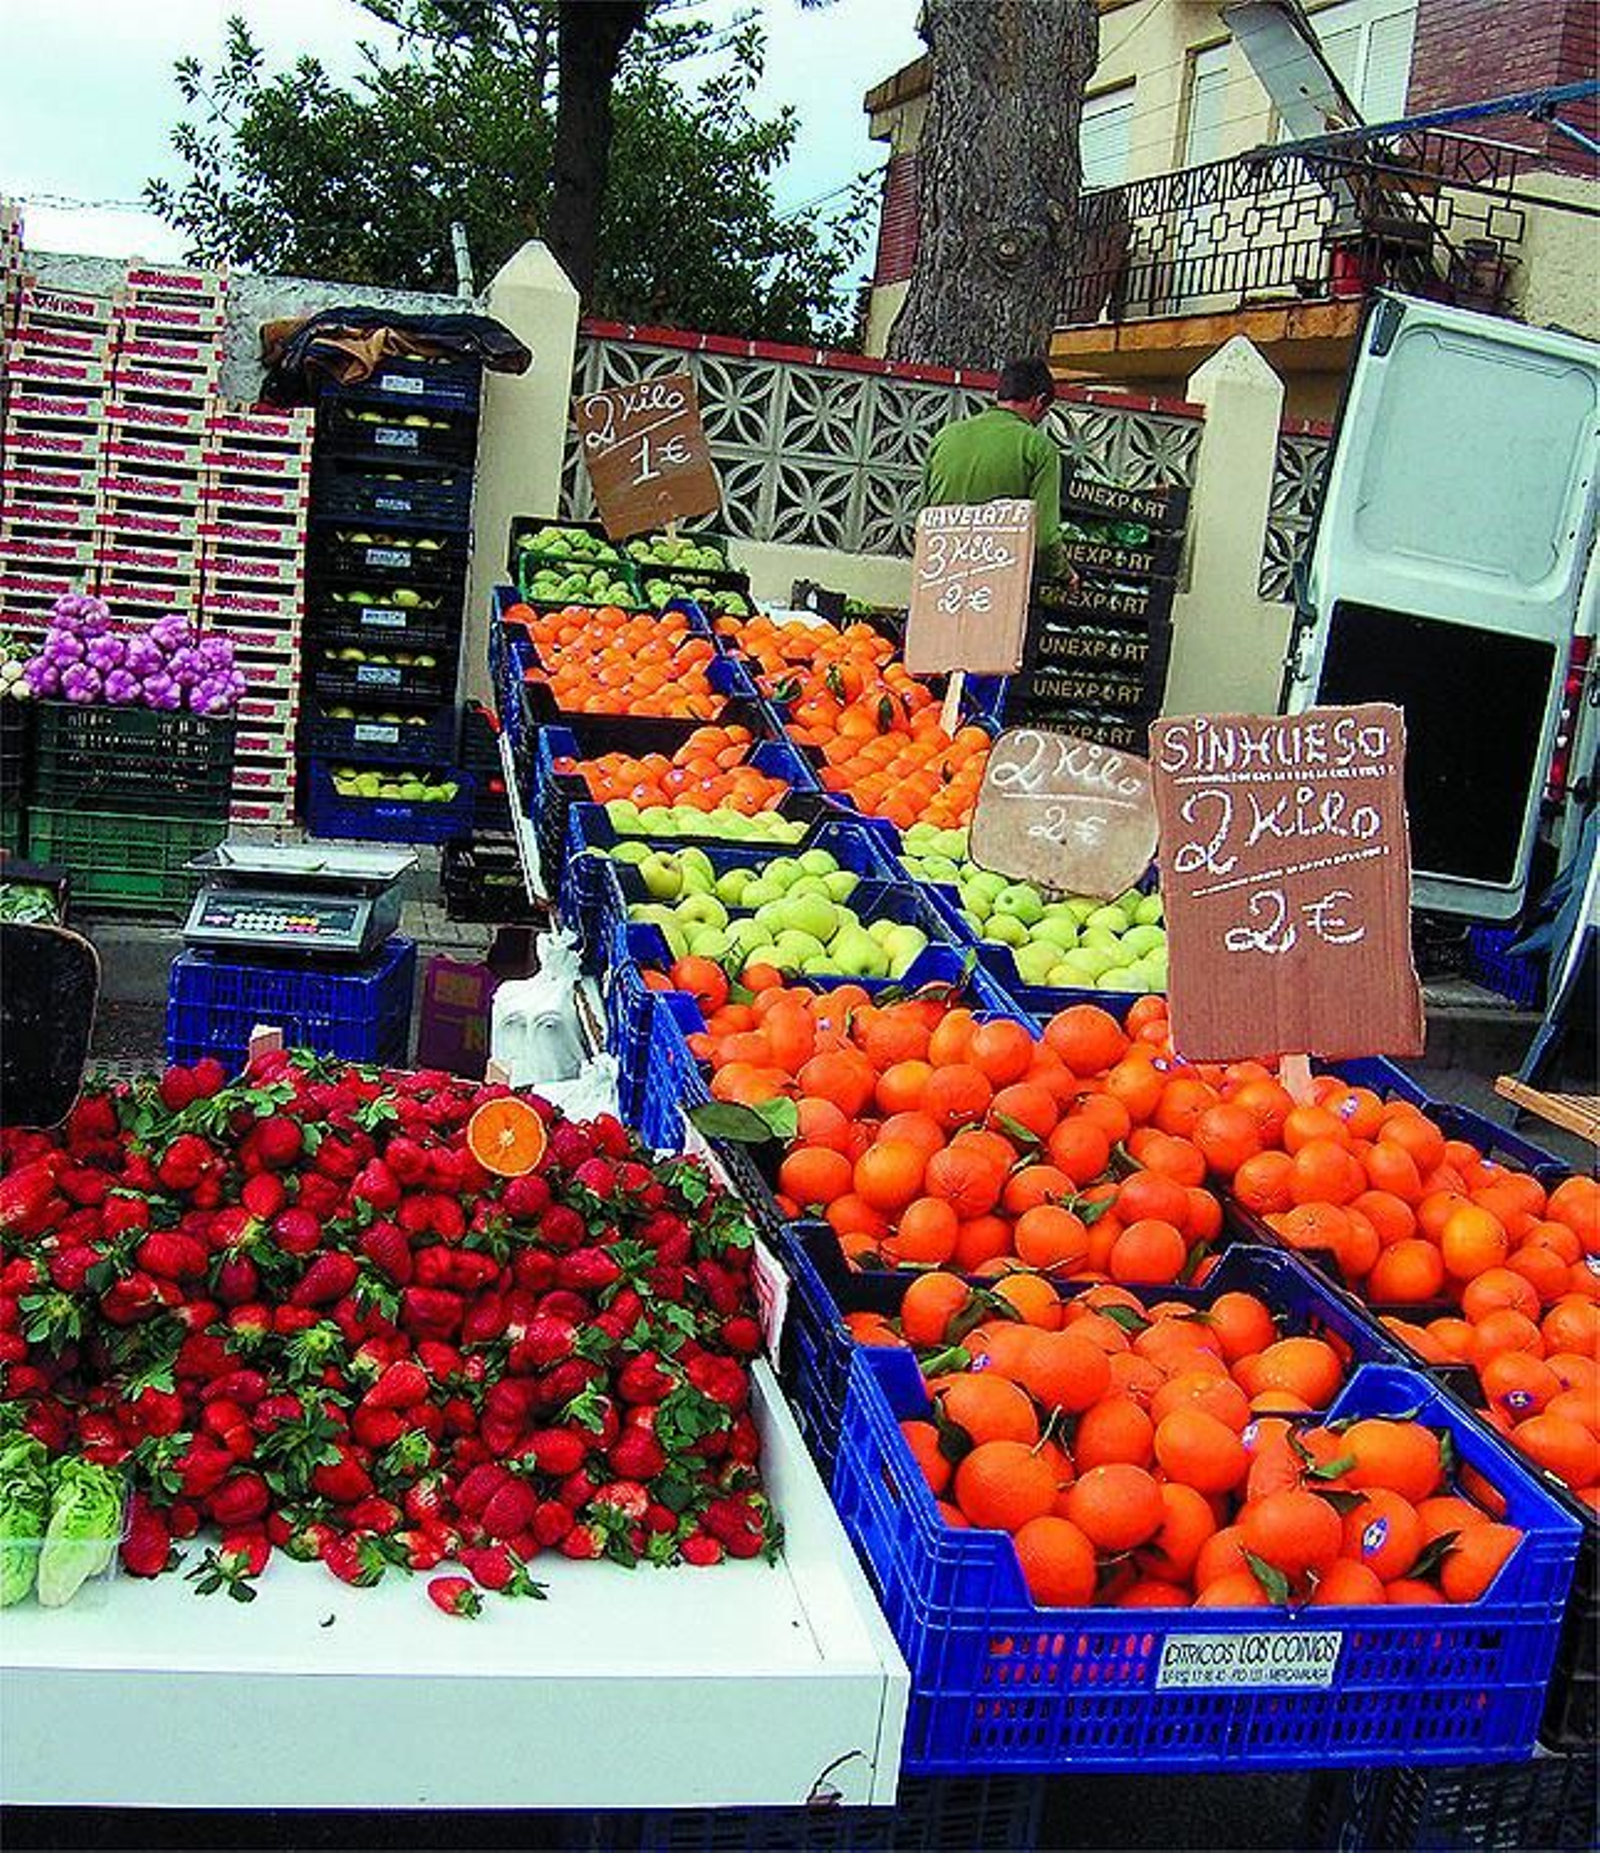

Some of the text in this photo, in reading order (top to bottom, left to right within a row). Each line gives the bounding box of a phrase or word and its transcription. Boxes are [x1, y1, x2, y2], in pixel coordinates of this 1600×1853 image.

[585, 395, 615, 447] 2
[1069, 480, 1167, 519] UNEXPORT
[919, 535, 947, 580] 3
[1038, 636, 1149, 661] UNEXPORT
[1033, 678, 1144, 703] UNEXPORT
[990, 730, 1045, 791] 2
[1174, 789, 1238, 875] 2
[1238, 1636, 1271, 1664] LOS
